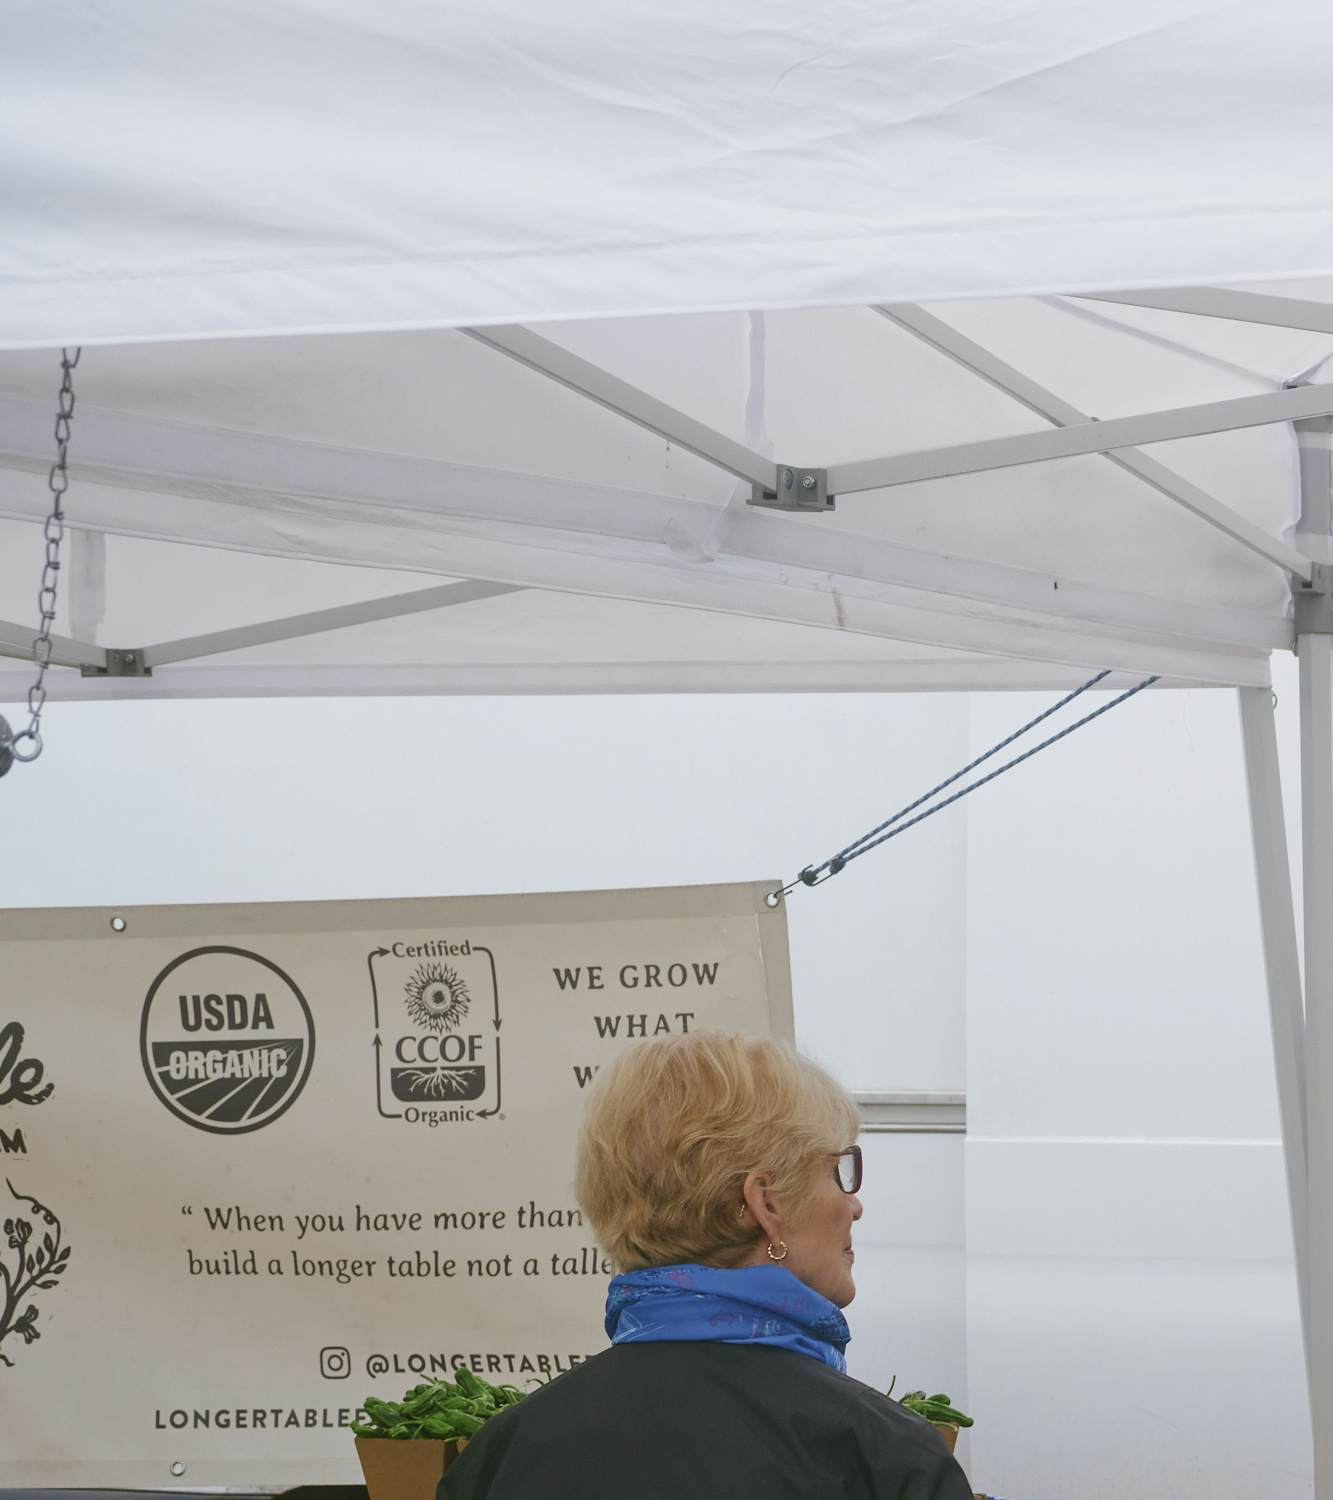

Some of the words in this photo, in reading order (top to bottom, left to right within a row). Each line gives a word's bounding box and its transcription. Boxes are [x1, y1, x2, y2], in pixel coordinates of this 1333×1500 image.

[392, 940, 472, 958] Certified
[553, 966, 605, 990] WE
[619, 963, 719, 988] GROW
[179, 993, 275, 1032] USDA
[594, 1013, 694, 1038] WHAT
[395, 1034, 482, 1063] CCOF
[169, 1049, 288, 1080] ORGANIC
[404, 1106, 474, 1127] Organic
[295, 1213, 345, 1239] you
[355, 1204, 422, 1231] have
[434, 1210, 506, 1230] more
[518, 1201, 583, 1228] than
[187, 1249, 259, 1275] build
[268, 1259, 284, 1276] a
[291, 1250, 376, 1284] longer
[387, 1250, 456, 1277] table
[467, 1254, 512, 1277] not
[523, 1257, 539, 1276] a
[552, 1247, 611, 1276] talle
